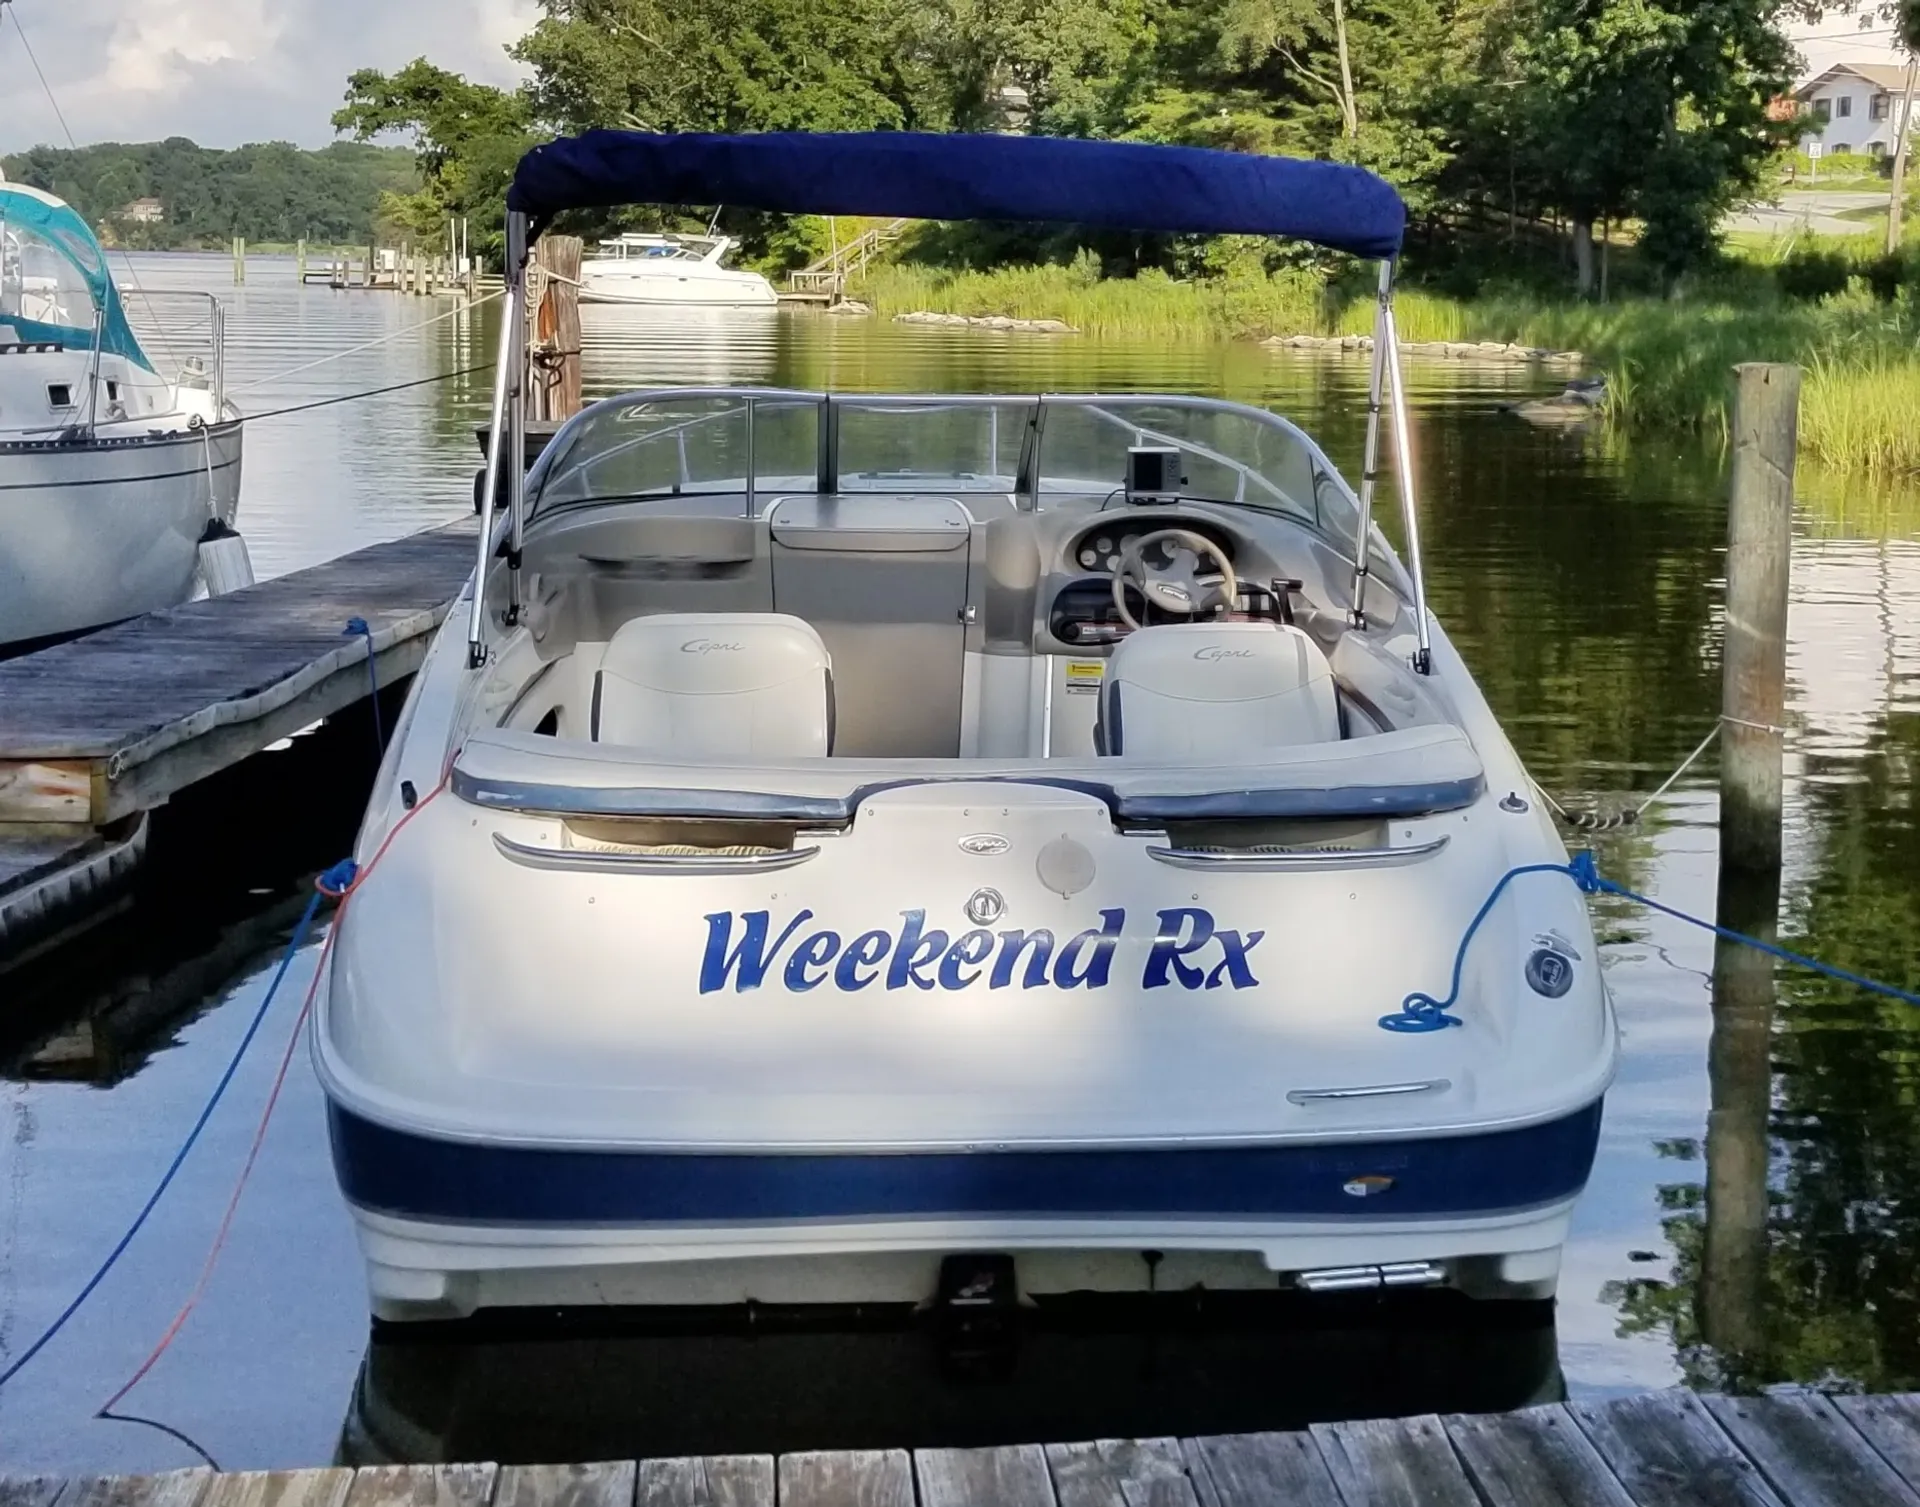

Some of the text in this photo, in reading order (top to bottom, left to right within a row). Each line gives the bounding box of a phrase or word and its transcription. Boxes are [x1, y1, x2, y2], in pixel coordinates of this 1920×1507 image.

[680, 638, 746, 656] Capri
[1193, 645, 1256, 663] Capri
[699, 907, 1265, 993] Weekend Rx
